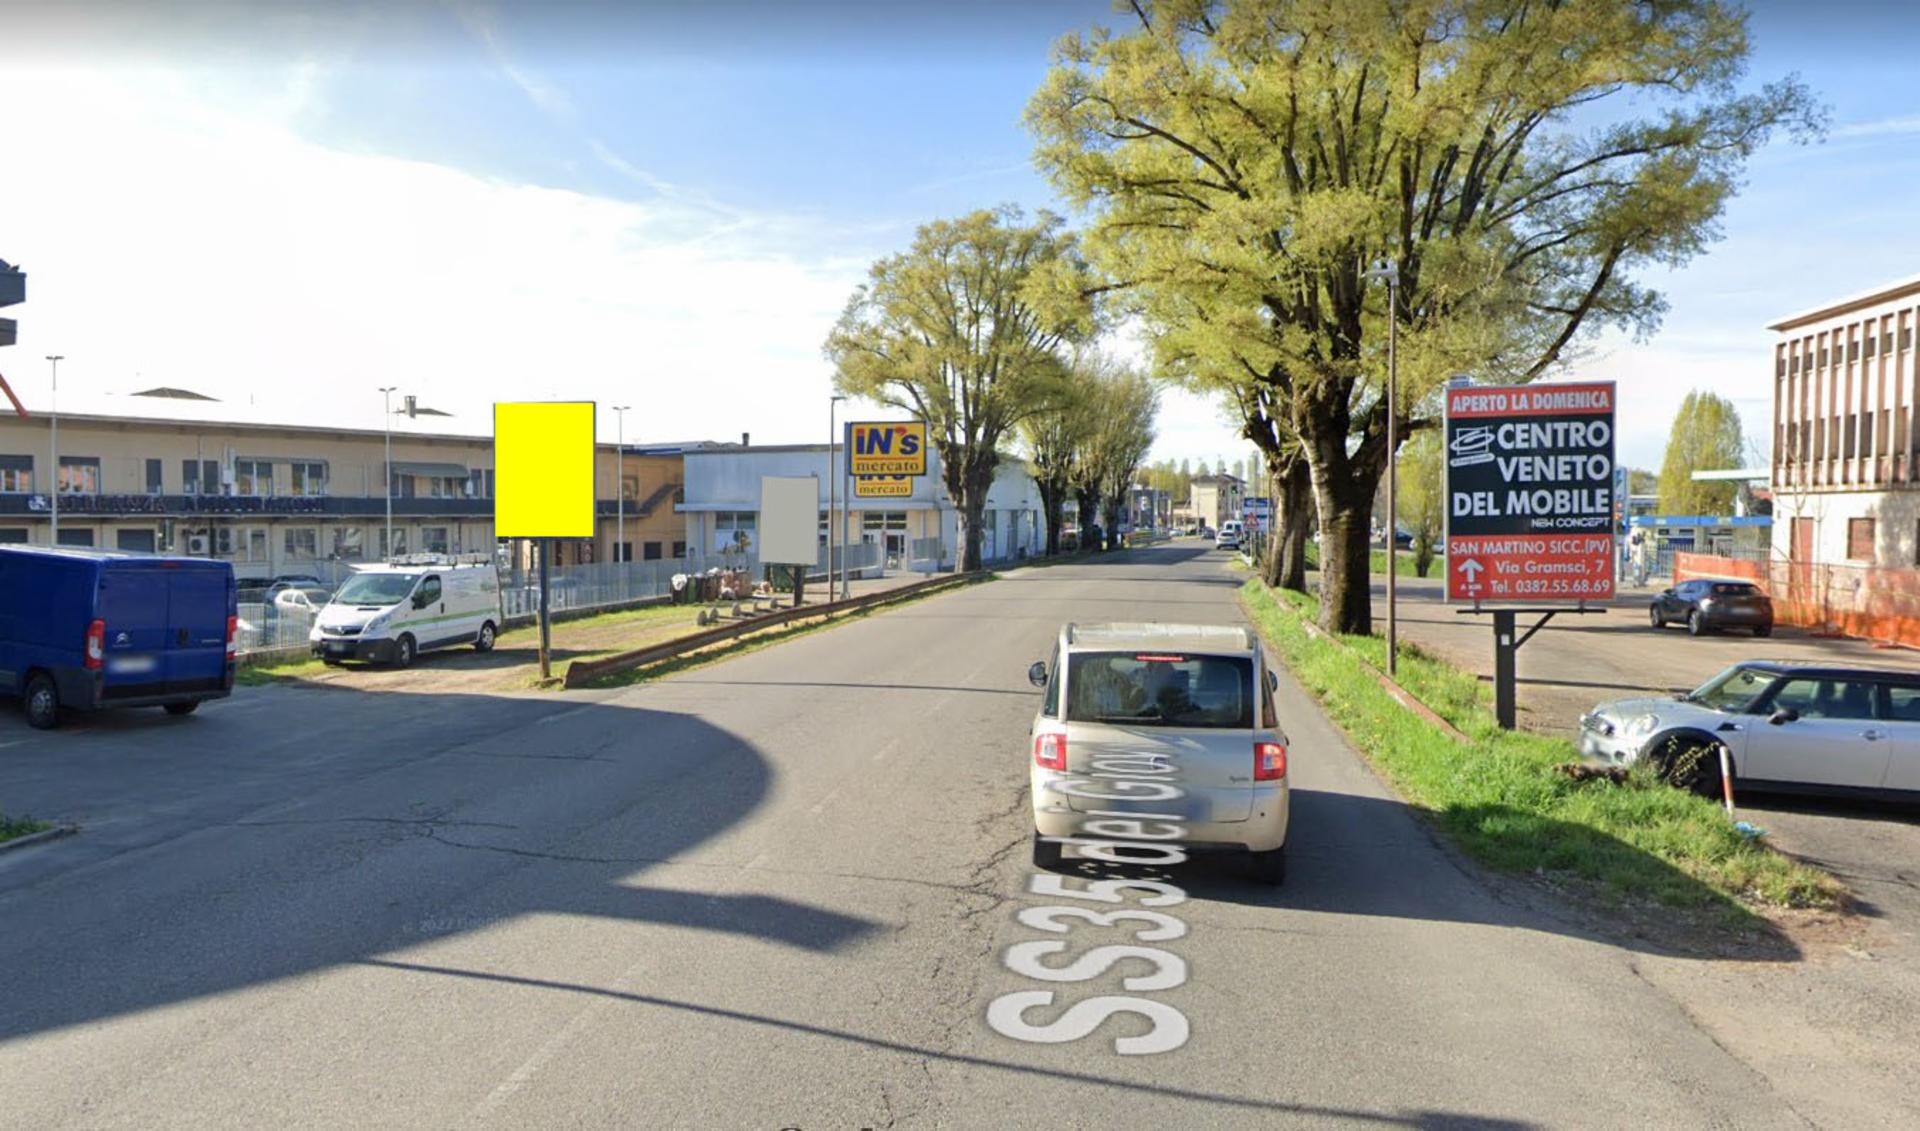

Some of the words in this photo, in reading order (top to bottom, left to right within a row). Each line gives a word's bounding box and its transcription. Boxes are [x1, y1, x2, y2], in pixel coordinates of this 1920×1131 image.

[1452, 394, 1507, 412] APERTO
[1511, 393, 1529, 410] LA
[1532, 391, 1609, 409] DOMENICA
[1497, 420, 1611, 450] CENTRO
[856, 460, 919, 472] mercato
[1496, 454, 1611, 482] VENETO
[859, 484, 908, 494] mercato
[1453, 491, 1501, 517] DEL
[1506, 489, 1610, 515] MOBILE
[1556, 517, 1611, 527] CONCEPT
[1451, 541, 1479, 555] SAN
[1482, 540, 1545, 554] MARTINO
[1495, 560, 1520, 573] Via
[1524, 559, 1591, 575] Gramsci,
[1595, 560, 1605, 573] 7
[1490, 579, 1512, 593] Tel.
[1515, 579, 1611, 593] 0382.55.68.69
